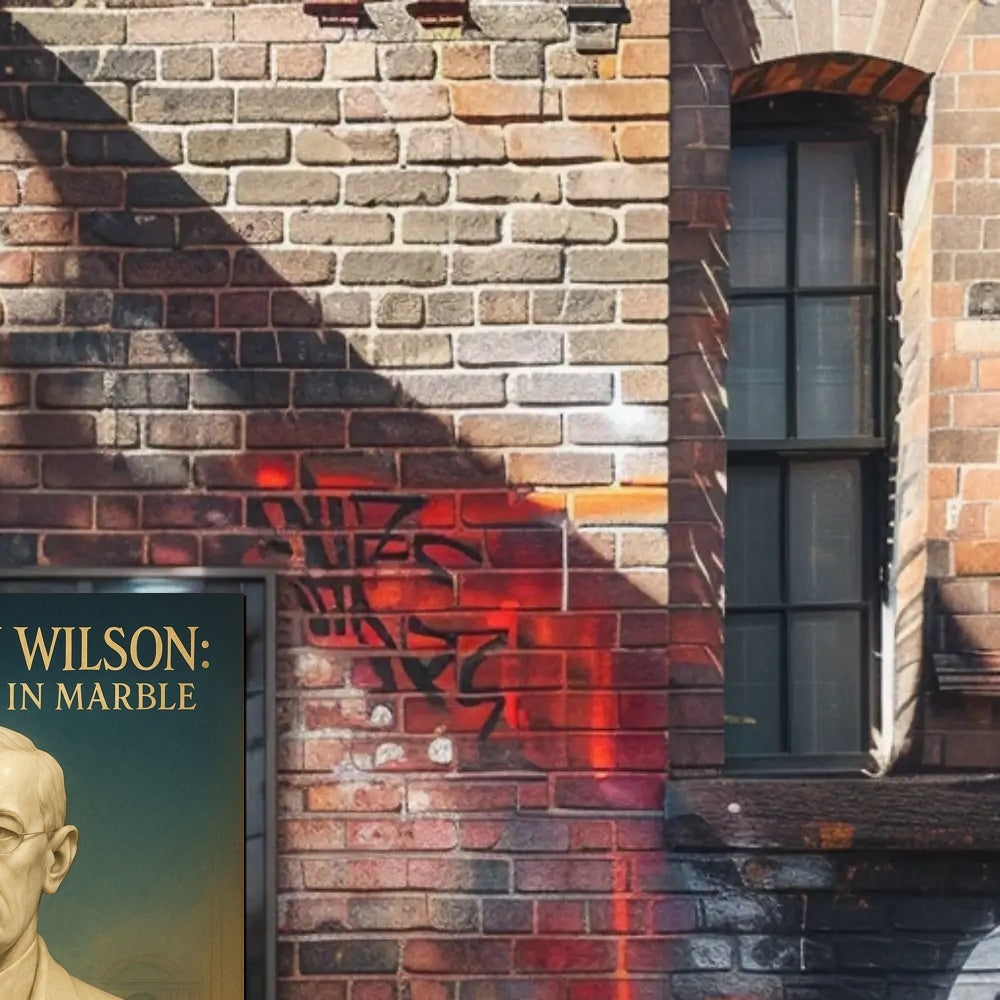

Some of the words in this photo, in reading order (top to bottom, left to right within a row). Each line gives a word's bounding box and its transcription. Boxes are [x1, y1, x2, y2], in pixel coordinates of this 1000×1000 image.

[12, 626, 210, 672] WILSON:
[7, 682, 45, 711] IN
[55, 682, 197, 711] MARBLE
